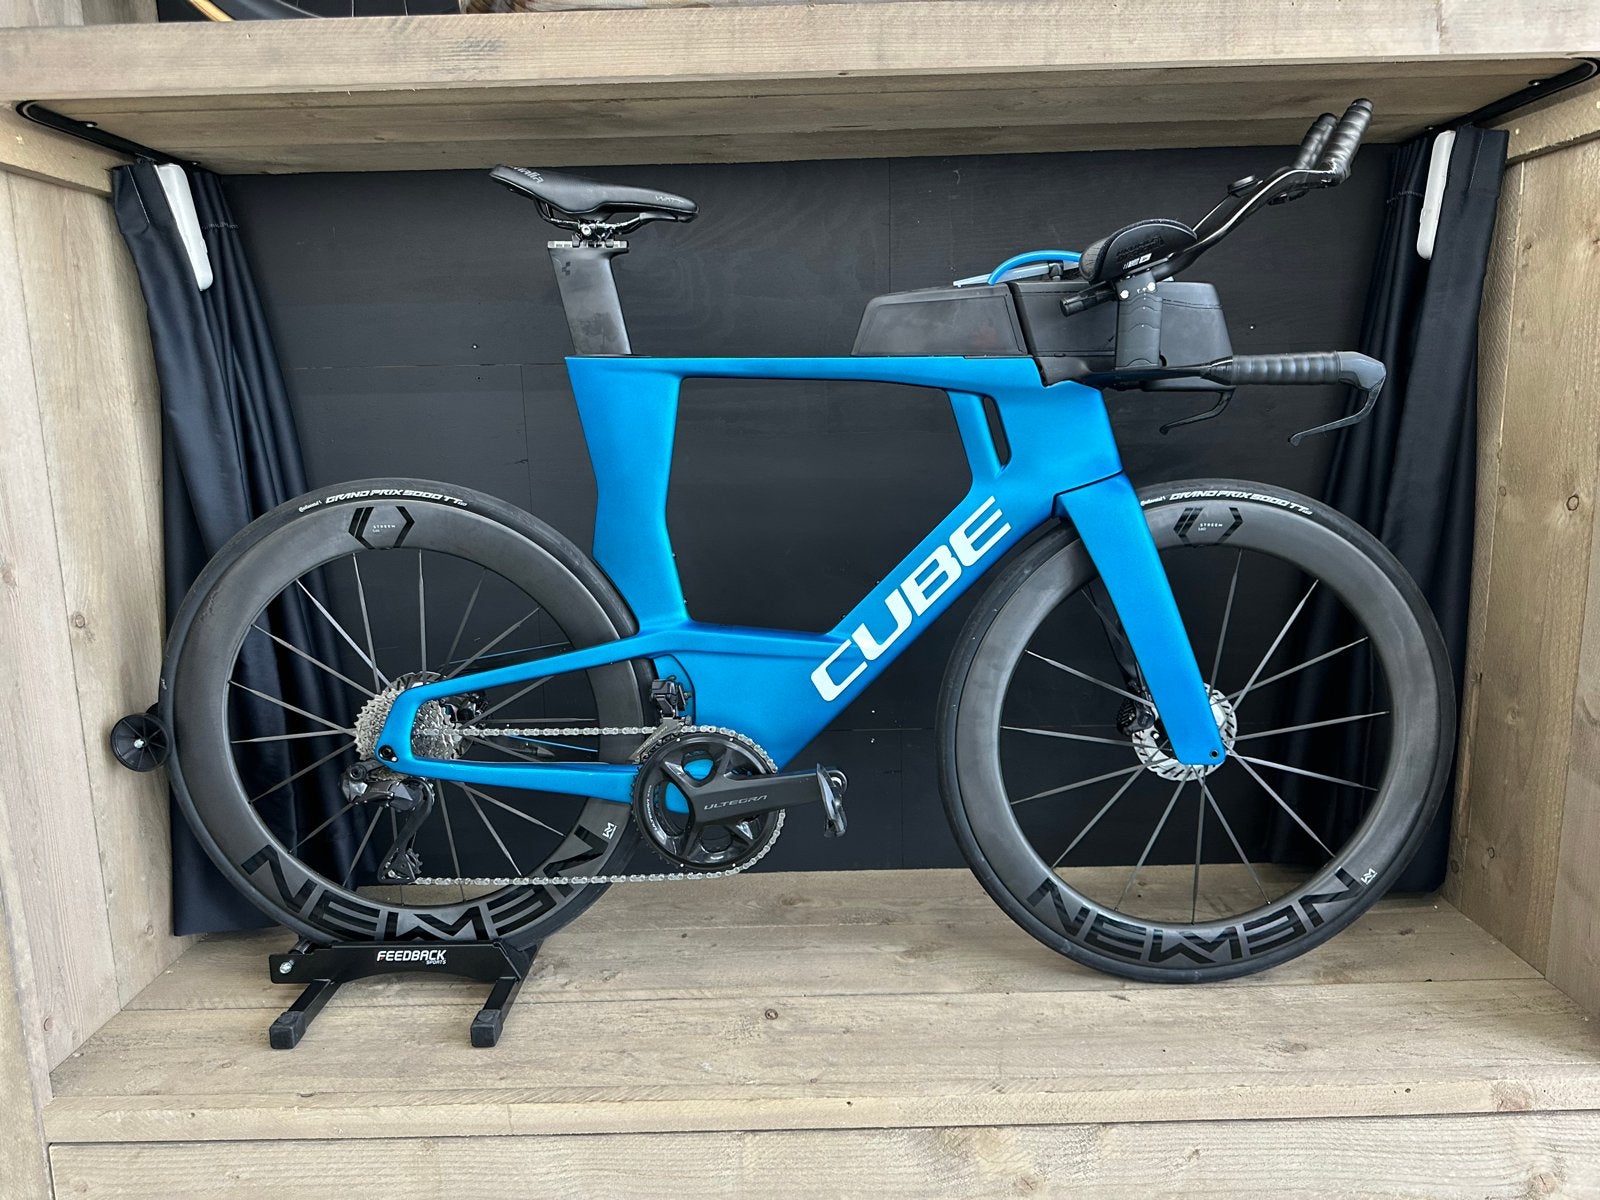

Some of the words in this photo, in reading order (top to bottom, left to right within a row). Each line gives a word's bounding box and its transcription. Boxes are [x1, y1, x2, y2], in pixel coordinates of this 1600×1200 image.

[325, 490, 370, 504] GRAND
[370, 489, 403, 497] PRIX
[402, 489, 443, 500] 5000
[1169, 490, 1218, 501] GRAND
[1216, 490, 1252, 499] PRIX
[1250, 493, 1290, 507] 5000
[811, 495, 1012, 702] CUBE
[704, 794, 768, 811] ULTEGRA
[1026, 867, 1363, 964] NEWMEN
[376, 949, 447, 962] FEEDBACK
